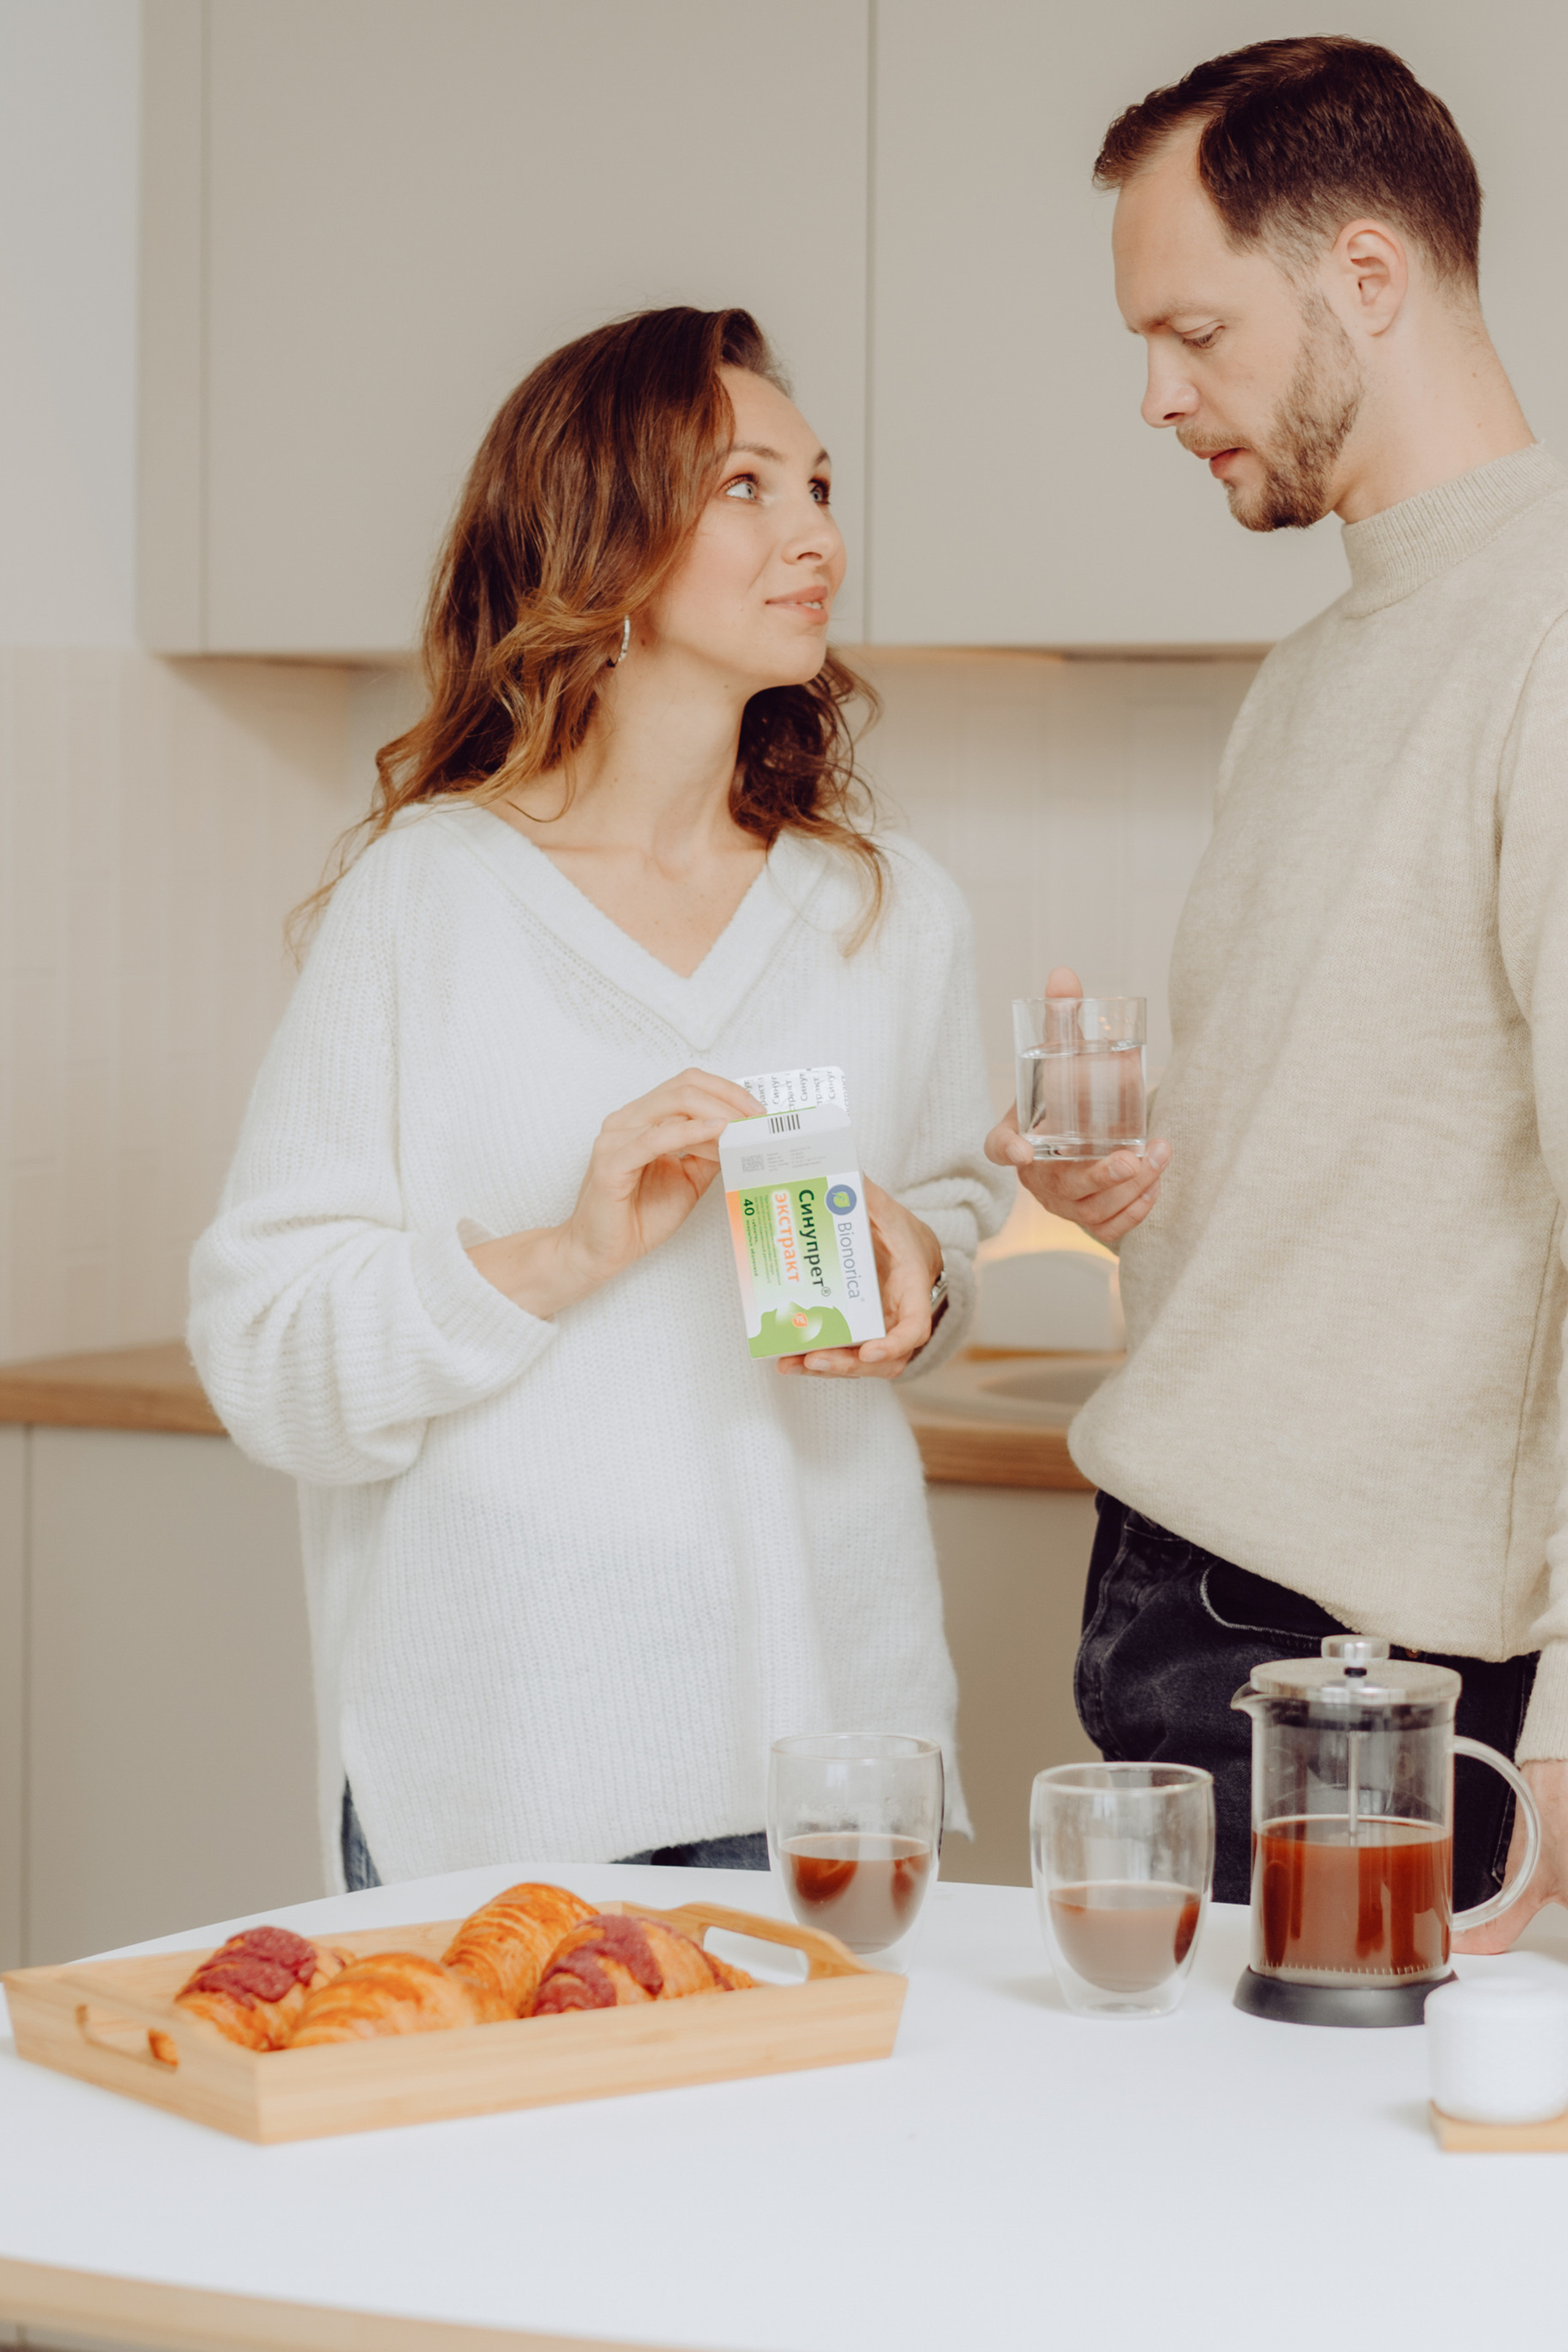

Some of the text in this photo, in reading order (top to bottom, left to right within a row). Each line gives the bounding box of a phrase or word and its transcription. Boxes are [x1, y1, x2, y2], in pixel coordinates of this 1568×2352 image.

[744, 1199, 755, 1216] 40
[775, 1193, 799, 1282] экстракт
[837, 1222, 861, 1298] Bionorica
